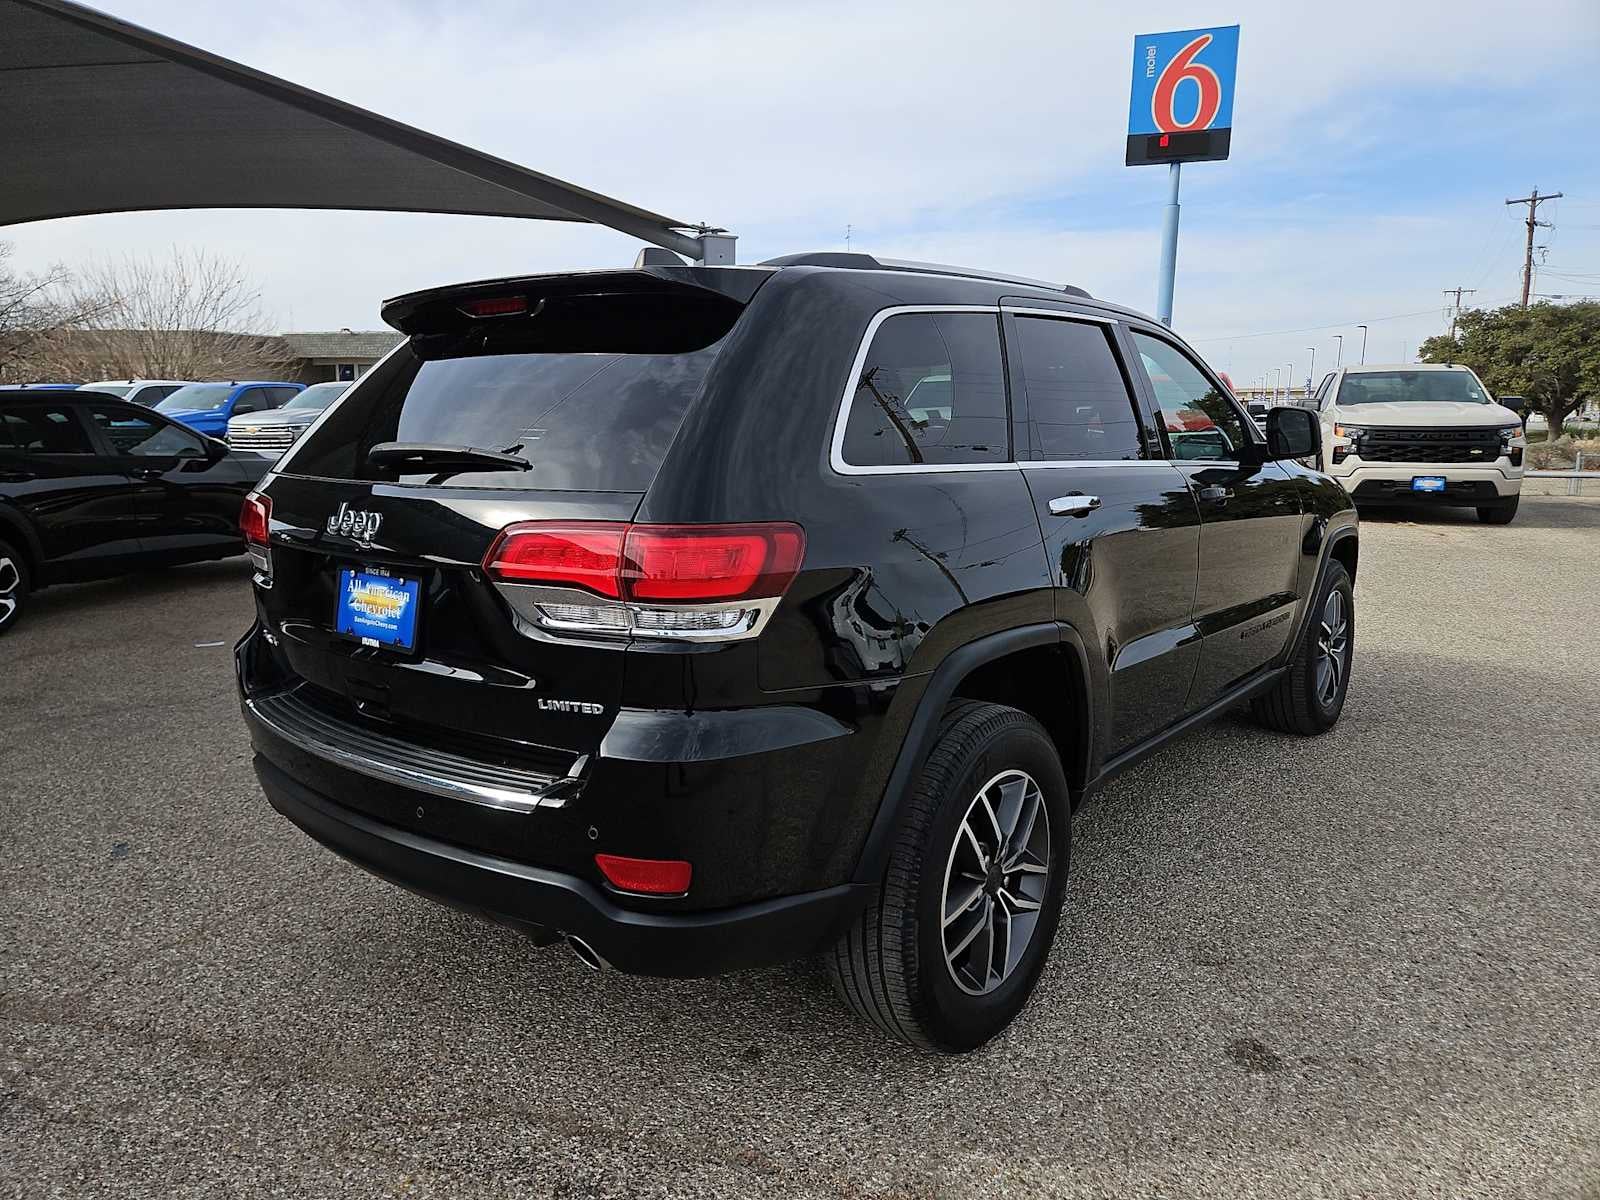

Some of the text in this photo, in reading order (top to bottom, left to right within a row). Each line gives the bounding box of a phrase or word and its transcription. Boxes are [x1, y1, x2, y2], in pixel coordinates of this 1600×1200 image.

[1146, 46, 1156, 78] motel
[1151, 33, 1221, 134] 6
[1374, 431, 1489, 441] CHEVROL
[327, 502, 383, 542] Jeep
[347, 579, 362, 592] All
[354, 598, 401, 619] Chevrolet
[537, 698, 604, 715] LIMITED
